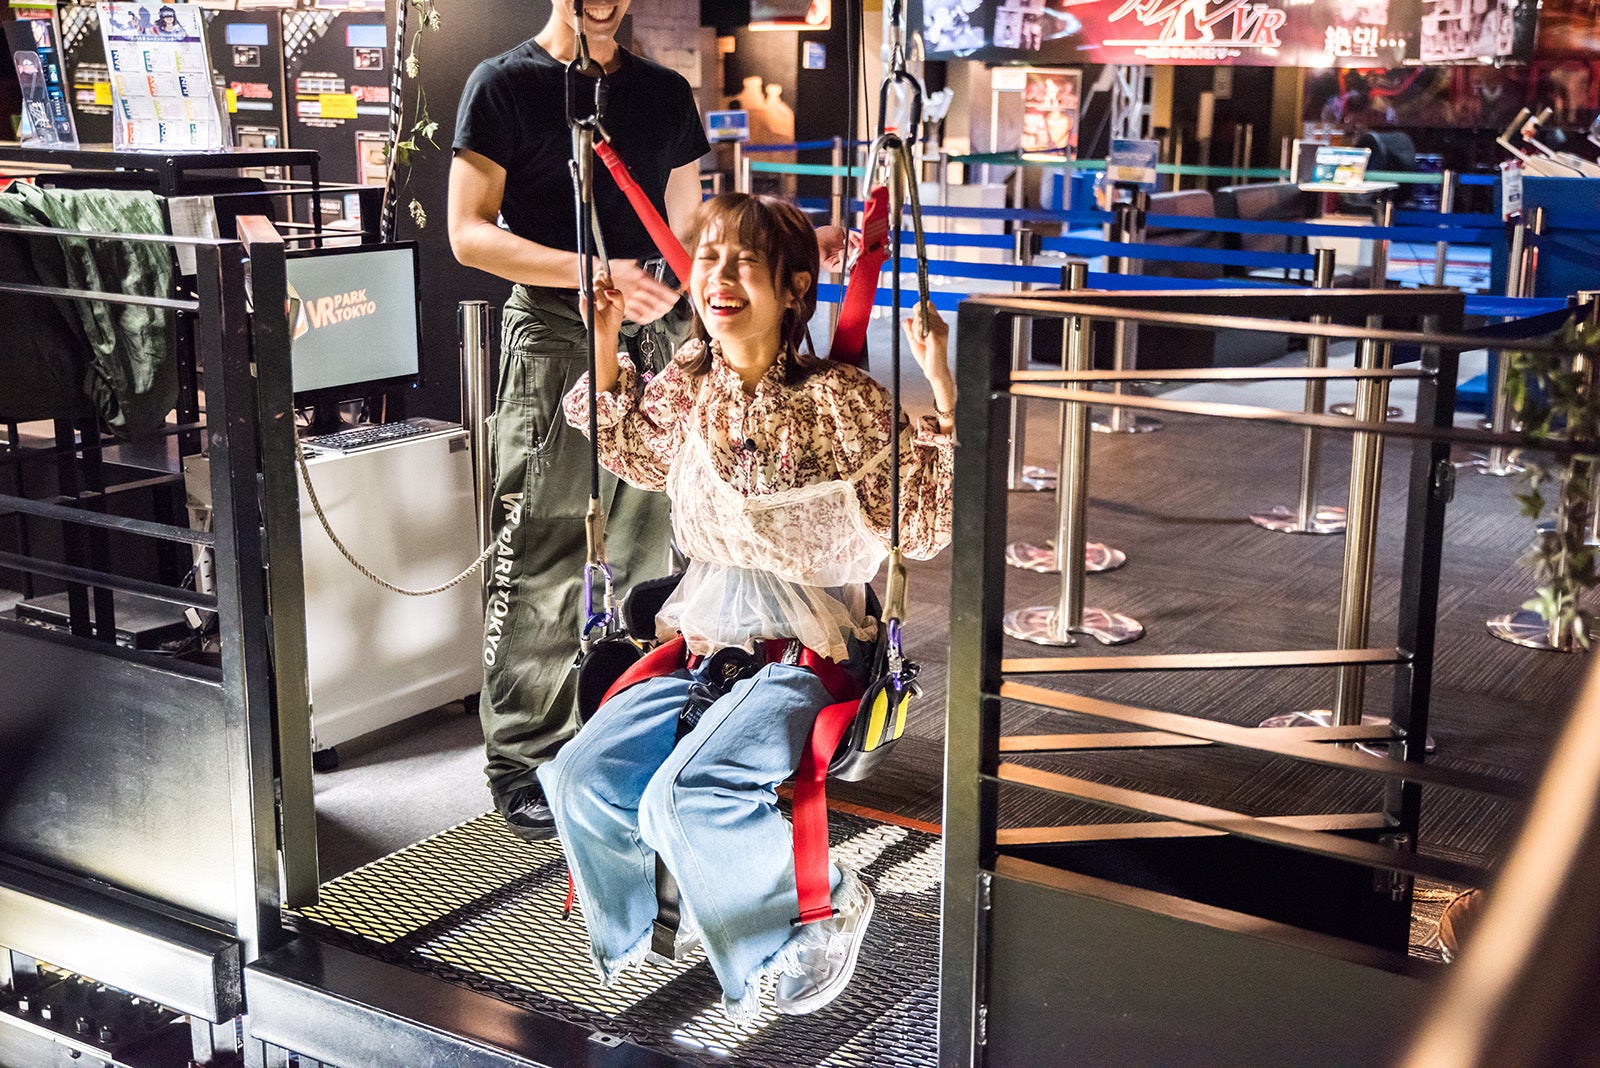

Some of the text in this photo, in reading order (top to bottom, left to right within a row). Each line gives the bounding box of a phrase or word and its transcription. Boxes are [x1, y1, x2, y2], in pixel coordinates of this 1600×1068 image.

[306, 288, 368, 329] VR PARK
[335, 301, 376, 323] TOKYO
[484, 492, 524, 667] VR PARK TOKYO
